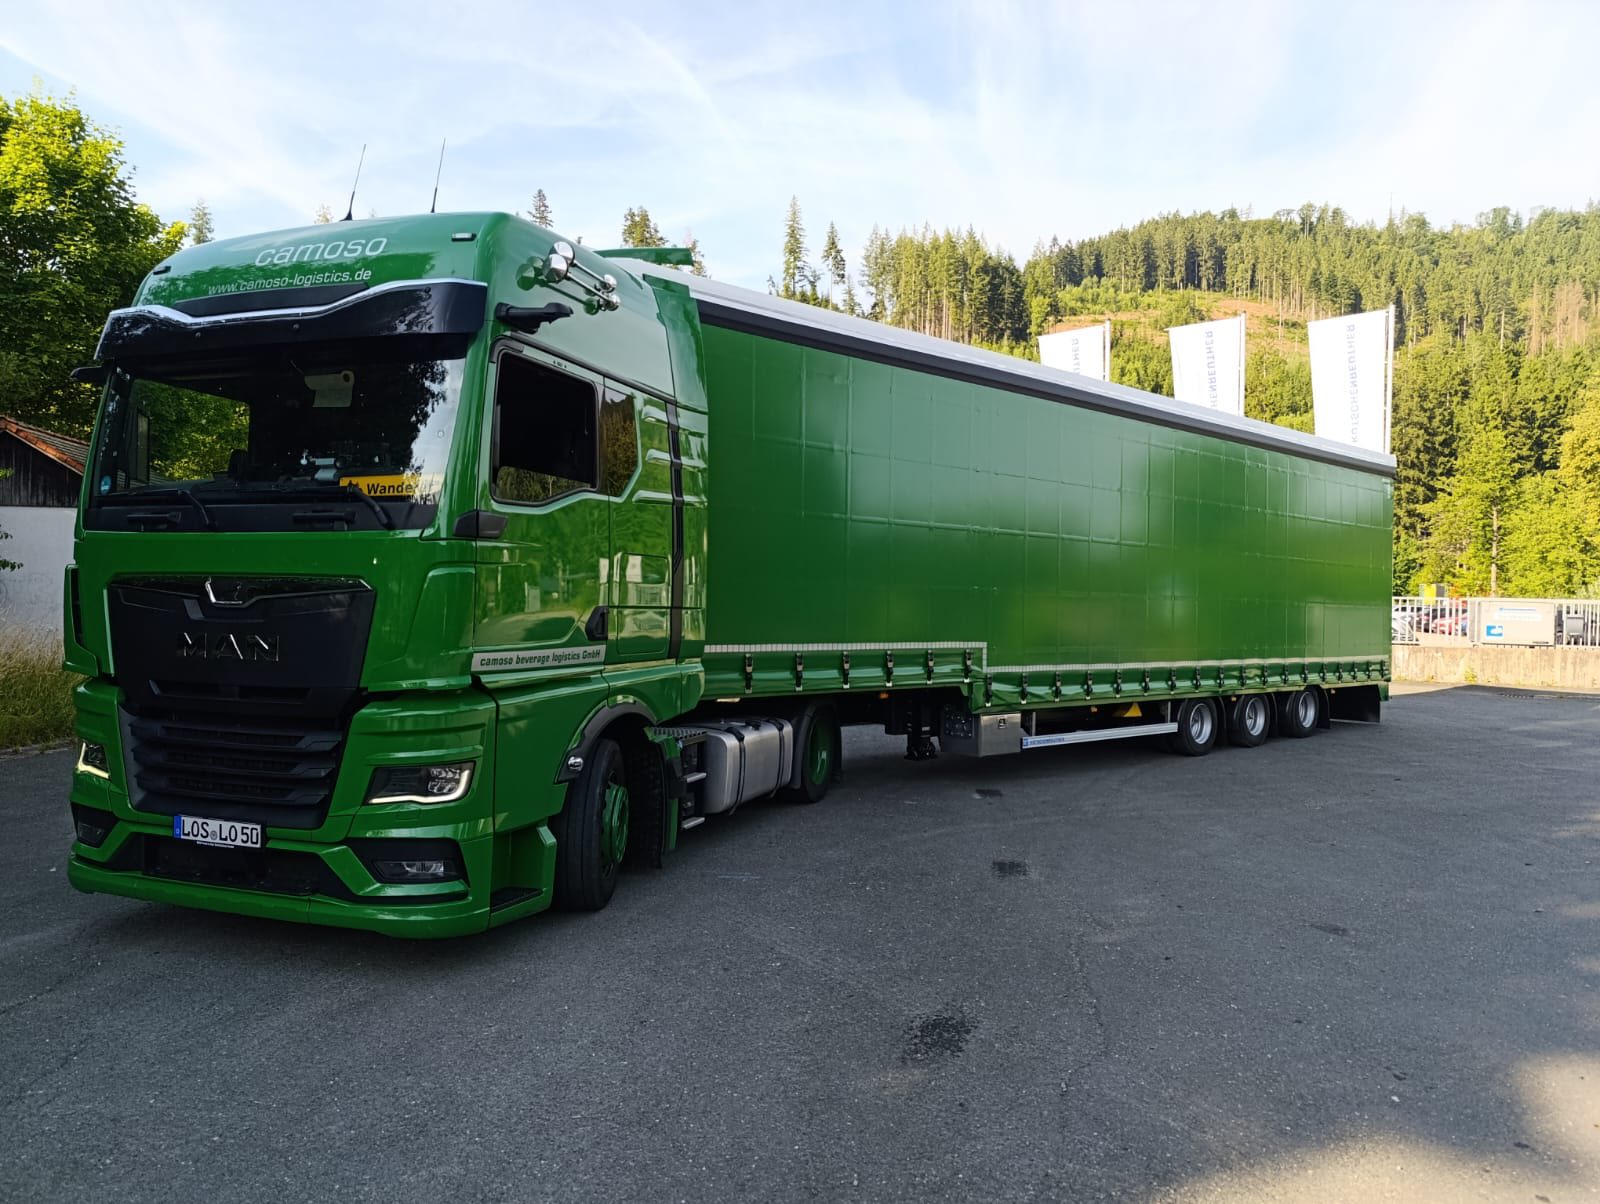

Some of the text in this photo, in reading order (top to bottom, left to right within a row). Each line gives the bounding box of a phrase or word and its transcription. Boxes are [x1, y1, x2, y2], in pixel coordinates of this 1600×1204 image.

[255, 237, 388, 267] camoso
[208, 268, 372, 295] www.camoso-logistics.de
[177, 631, 280, 662] MAN
[480, 649, 600, 667] camoso beverage logistics GmbH
[182, 819, 259, 845] LOS LO 50
